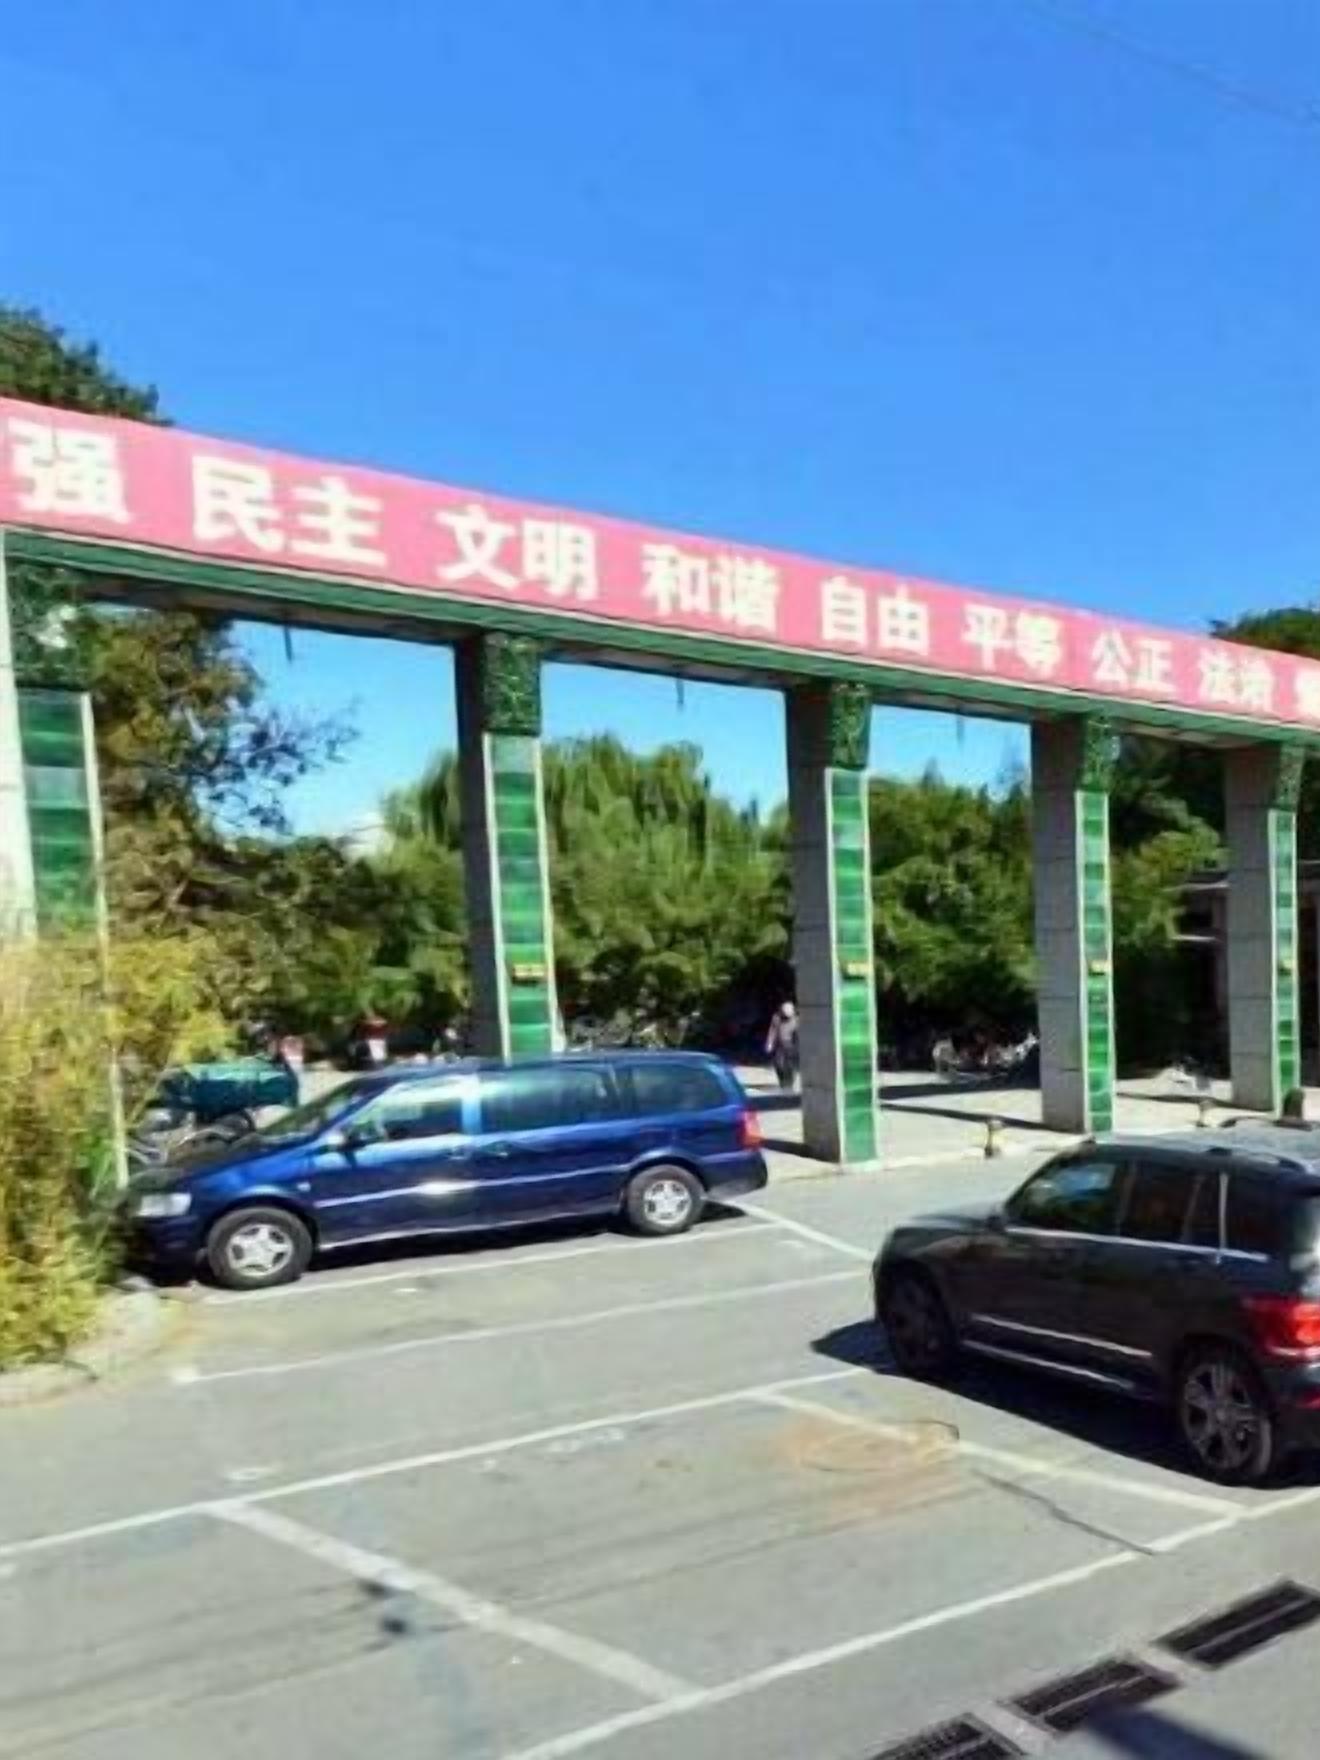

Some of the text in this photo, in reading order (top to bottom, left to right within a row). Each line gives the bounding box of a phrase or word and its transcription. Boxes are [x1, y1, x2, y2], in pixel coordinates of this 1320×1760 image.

[7, 416, 131, 525] 强
[192, 454, 388, 567] 民主
[434, 504, 598, 601] 文明
[641, 544, 779, 638] 和谐
[821, 575, 930, 655] 自由
[961, 602, 1062, 679] 平等
[1091, 628, 1177, 693] 公正
